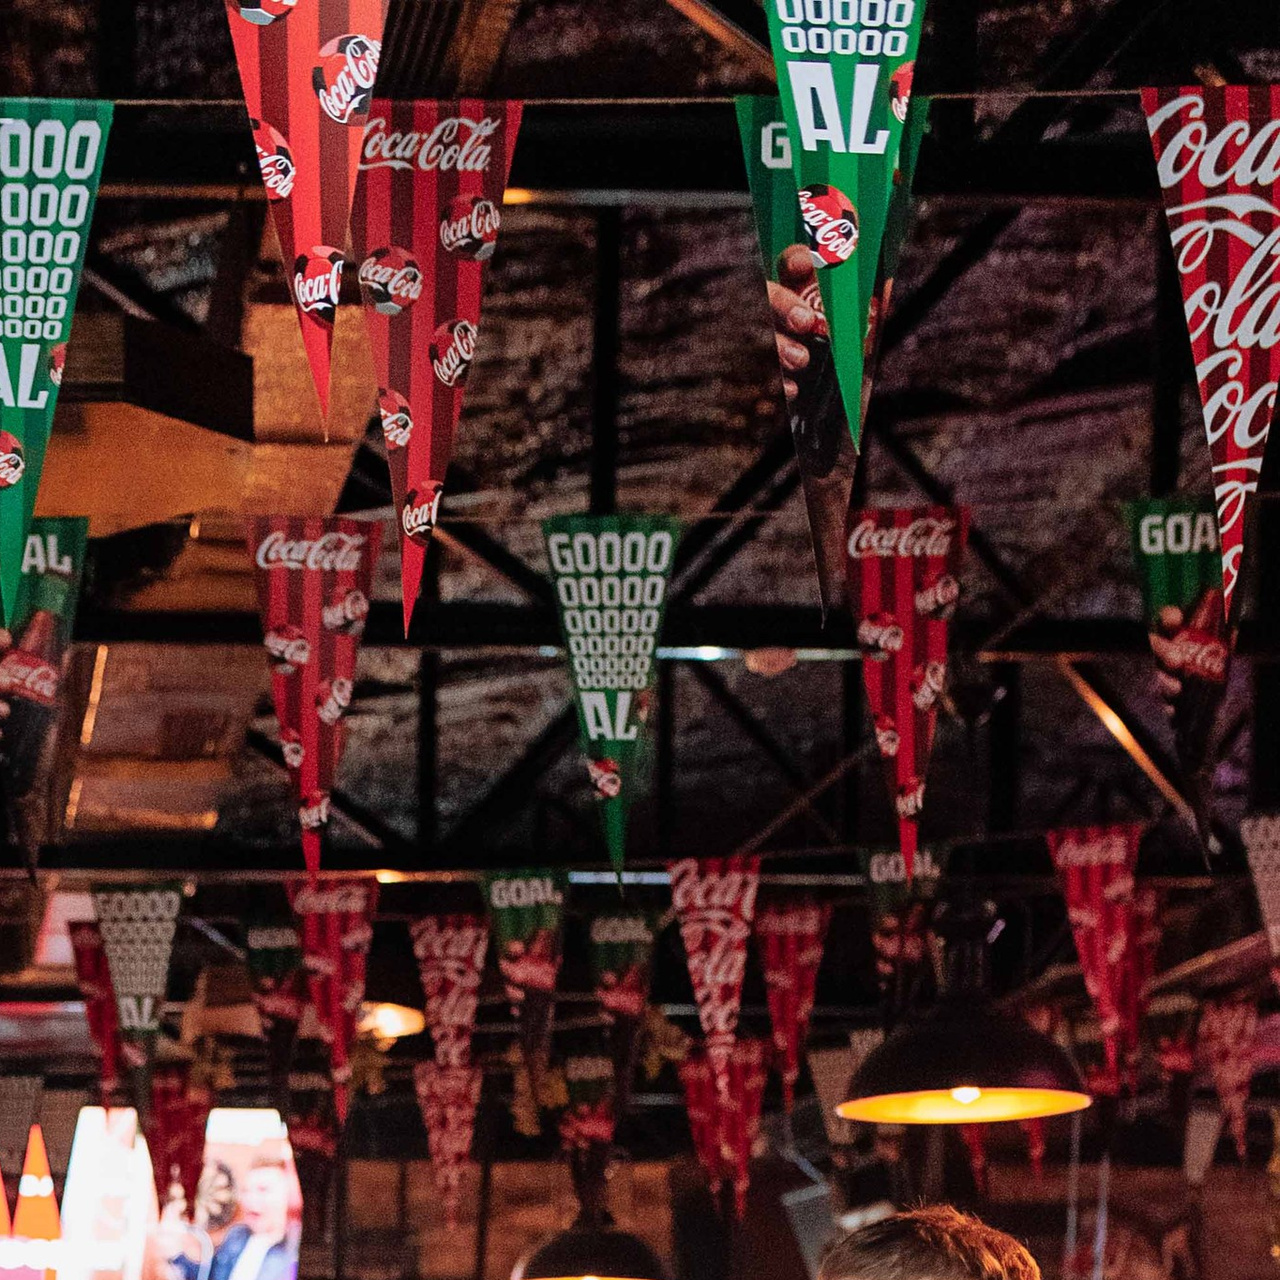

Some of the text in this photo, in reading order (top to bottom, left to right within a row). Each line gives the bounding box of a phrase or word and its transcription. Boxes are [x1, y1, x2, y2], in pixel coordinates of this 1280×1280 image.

[786, 60, 891, 155] AL
[1140, 512, 1219, 555] GOA
[581, 691, 638, 741] AL
